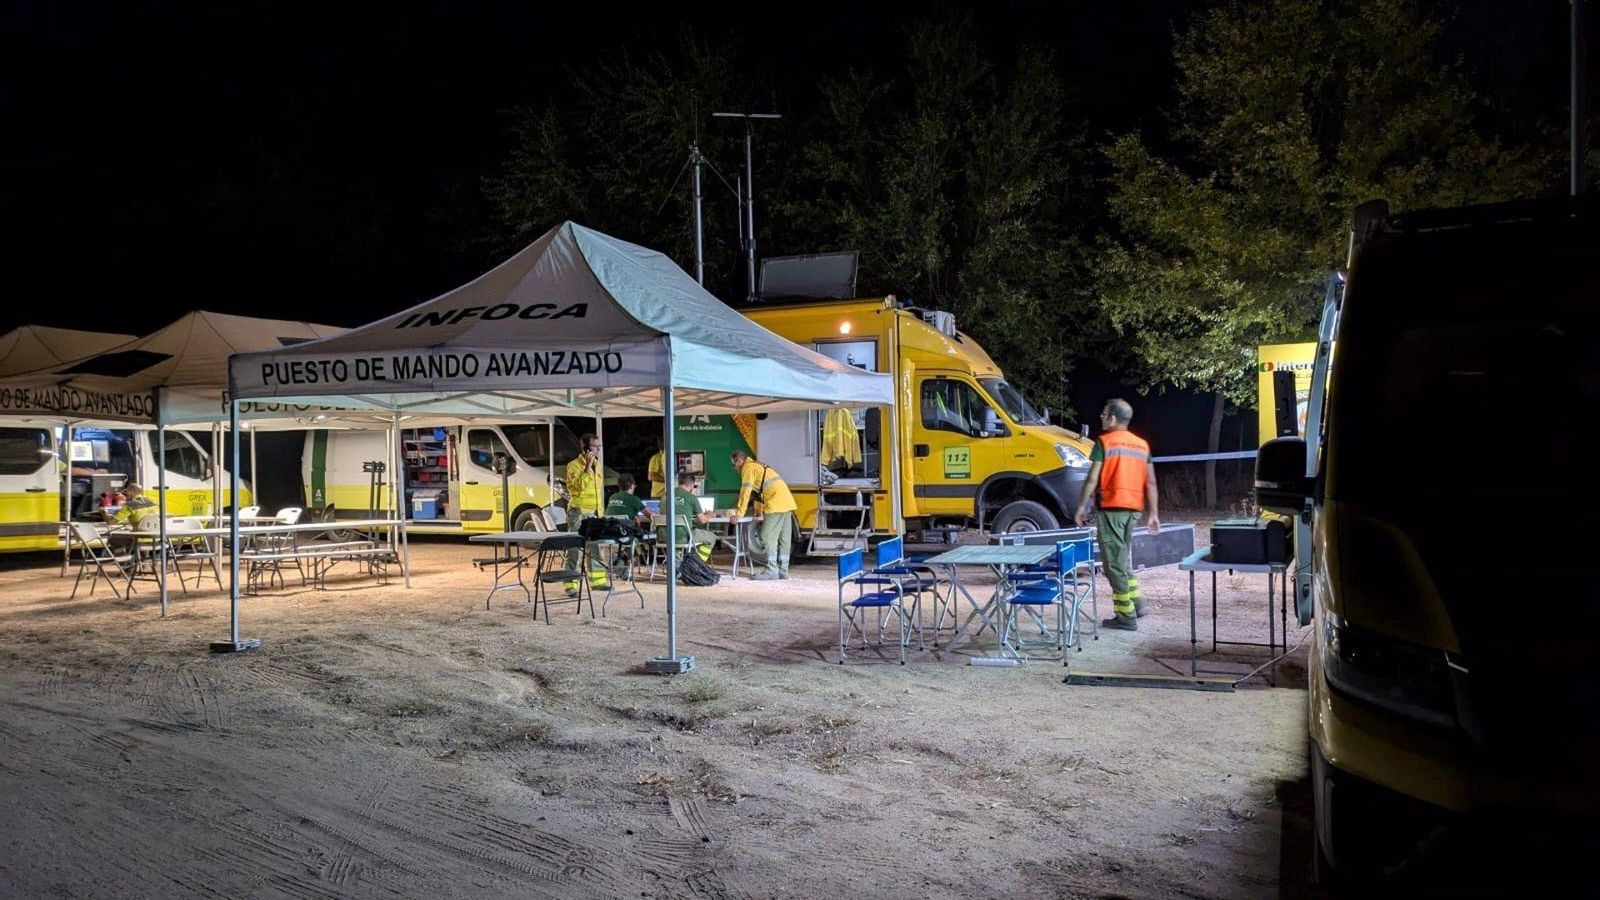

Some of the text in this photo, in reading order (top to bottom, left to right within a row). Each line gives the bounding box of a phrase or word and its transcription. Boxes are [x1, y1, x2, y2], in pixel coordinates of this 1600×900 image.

[395, 303, 589, 329] INFOCA
[262, 351, 623, 385] PUESTO DE MANDO AVANZADO
[15, 388, 30, 408] DE
[33, 386, 81, 411] MANDO
[84, 391, 155, 418] AVANZADO
[948, 453, 968, 463] 112
